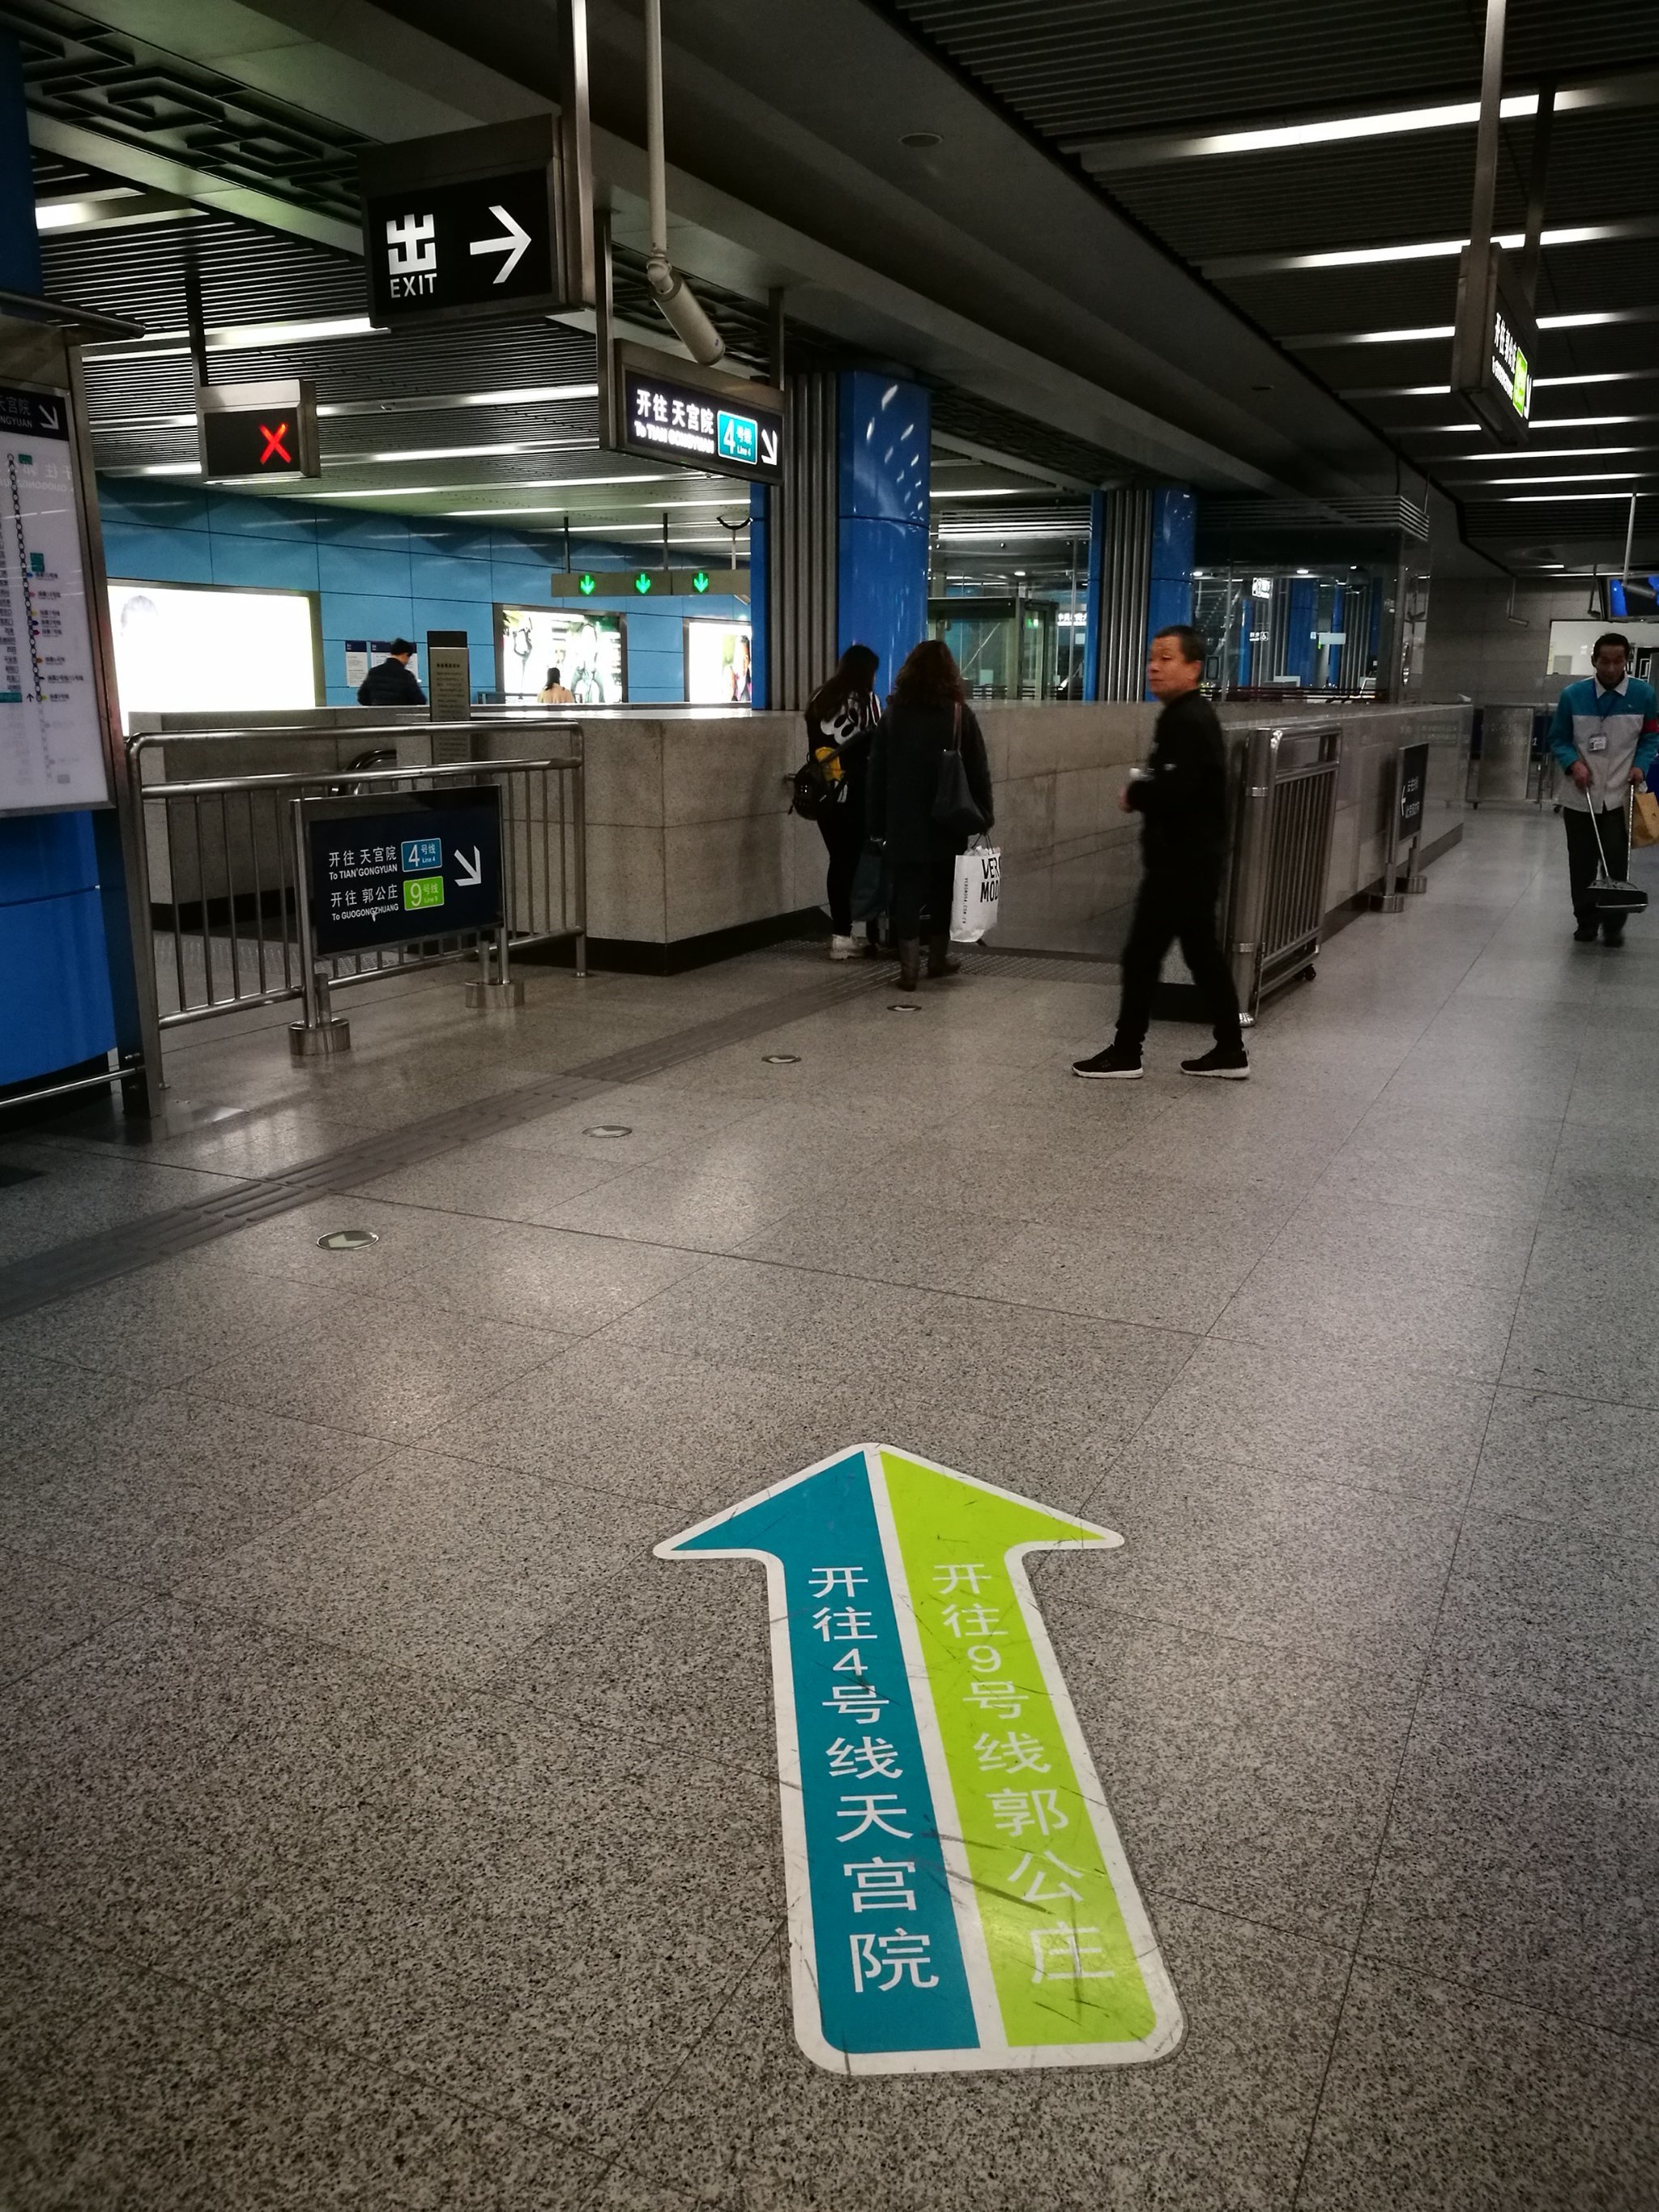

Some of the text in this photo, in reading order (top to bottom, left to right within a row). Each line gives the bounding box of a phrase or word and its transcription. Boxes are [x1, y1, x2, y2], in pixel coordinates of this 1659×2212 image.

[386, 214, 437, 275] 出
[390, 273, 437, 298] EXIT
[636, 389, 714, 435] 开往 天宫院
[634, 420, 646, 438] To
[329, 845, 397, 867] 开往 天宫院
[329, 863, 398, 880] To TIAN'GONGYUAN
[331, 884, 398, 908] 开往 郭公庄
[332, 903, 399, 921] To GUOGONGZHUANG
[808, 1566, 940, 1993] 开往4号线天宫院
[932, 1563, 1115, 1984] 开往9号线郭公庄
